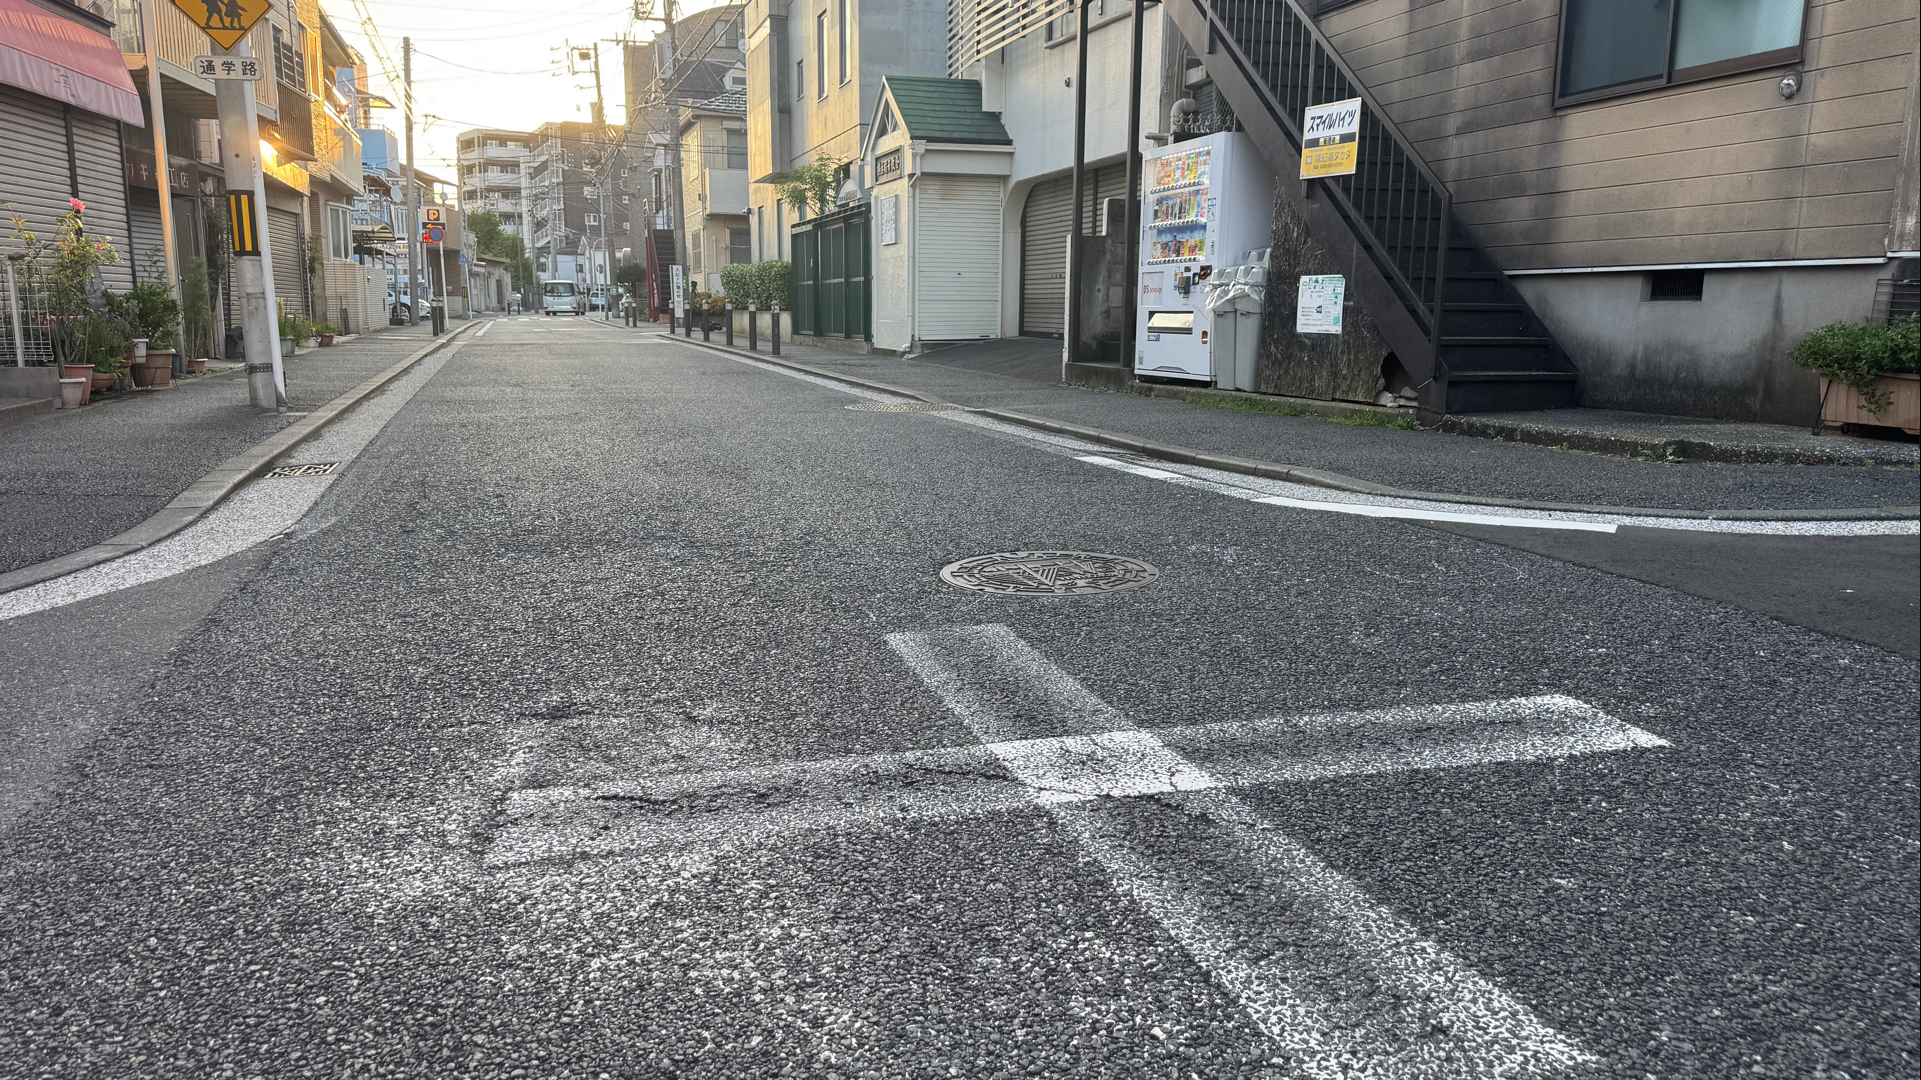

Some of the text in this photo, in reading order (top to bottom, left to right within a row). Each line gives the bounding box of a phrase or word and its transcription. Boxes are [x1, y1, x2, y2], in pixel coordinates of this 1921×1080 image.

[200, 60, 257, 76] 通学路
[1307, 109, 1357, 133] スマイルハイツ
[429, 210, 438, 221] P
